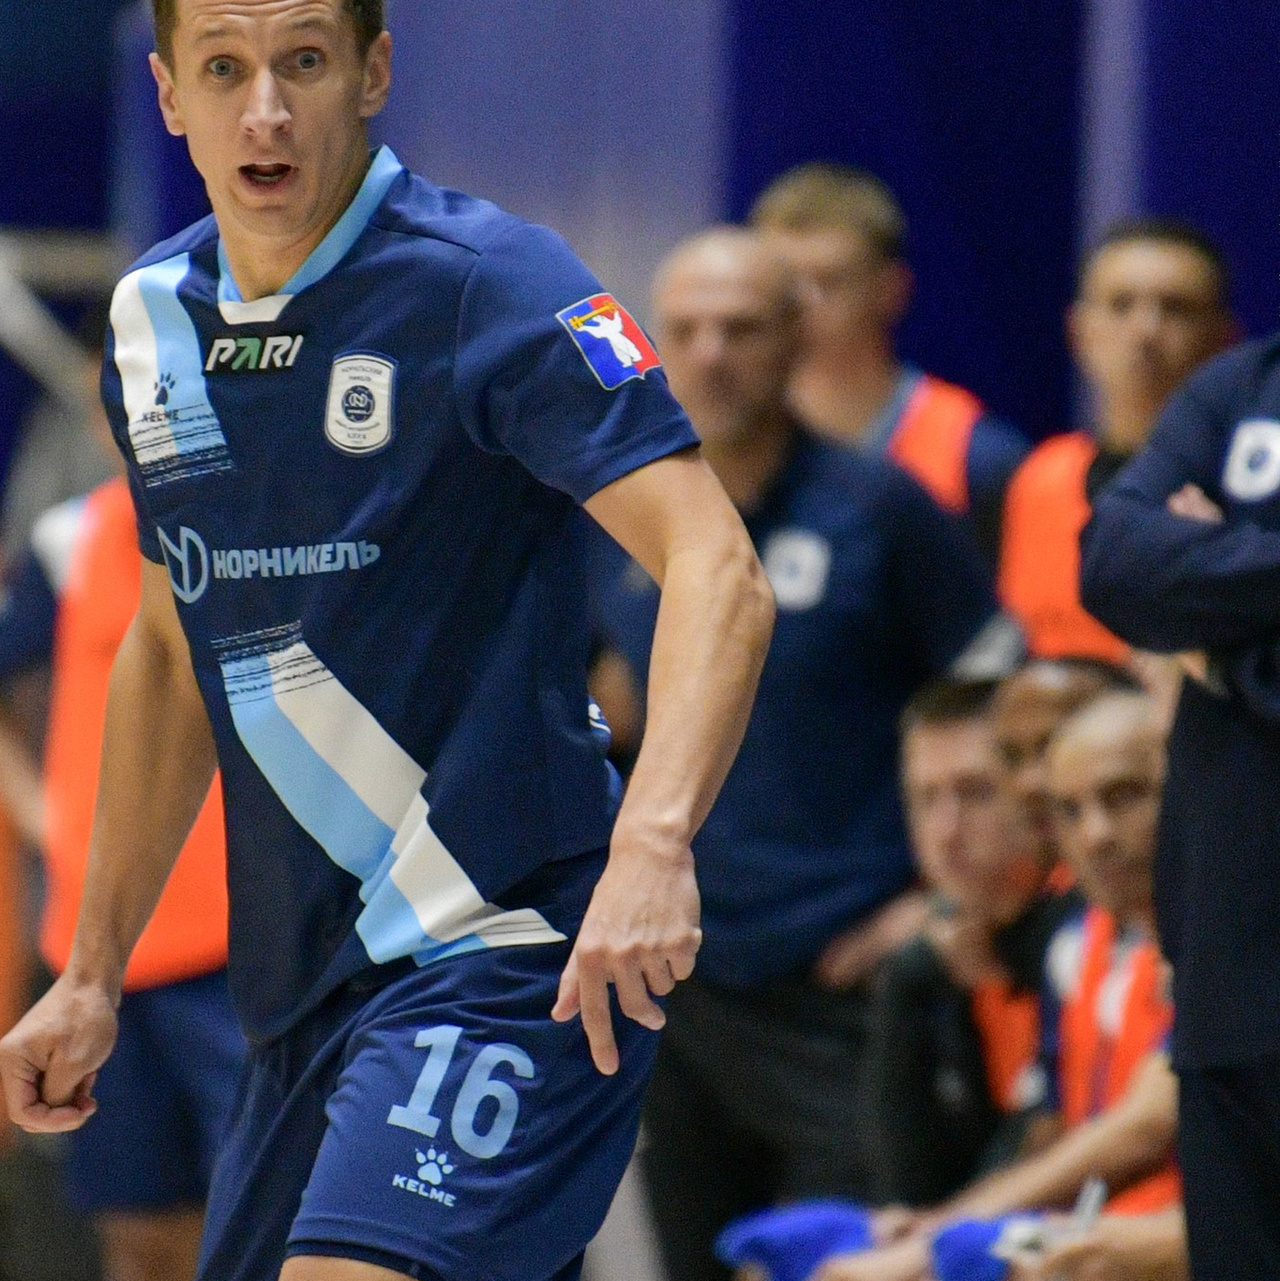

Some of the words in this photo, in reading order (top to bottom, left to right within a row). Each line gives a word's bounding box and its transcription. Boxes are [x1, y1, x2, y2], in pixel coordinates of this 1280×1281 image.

[205, 334, 304, 371] PARI
[212, 540, 381, 580] НОРНИКЕЛЬ
[387, 1024, 535, 1159] 16
[392, 1174, 457, 1207] KELME
